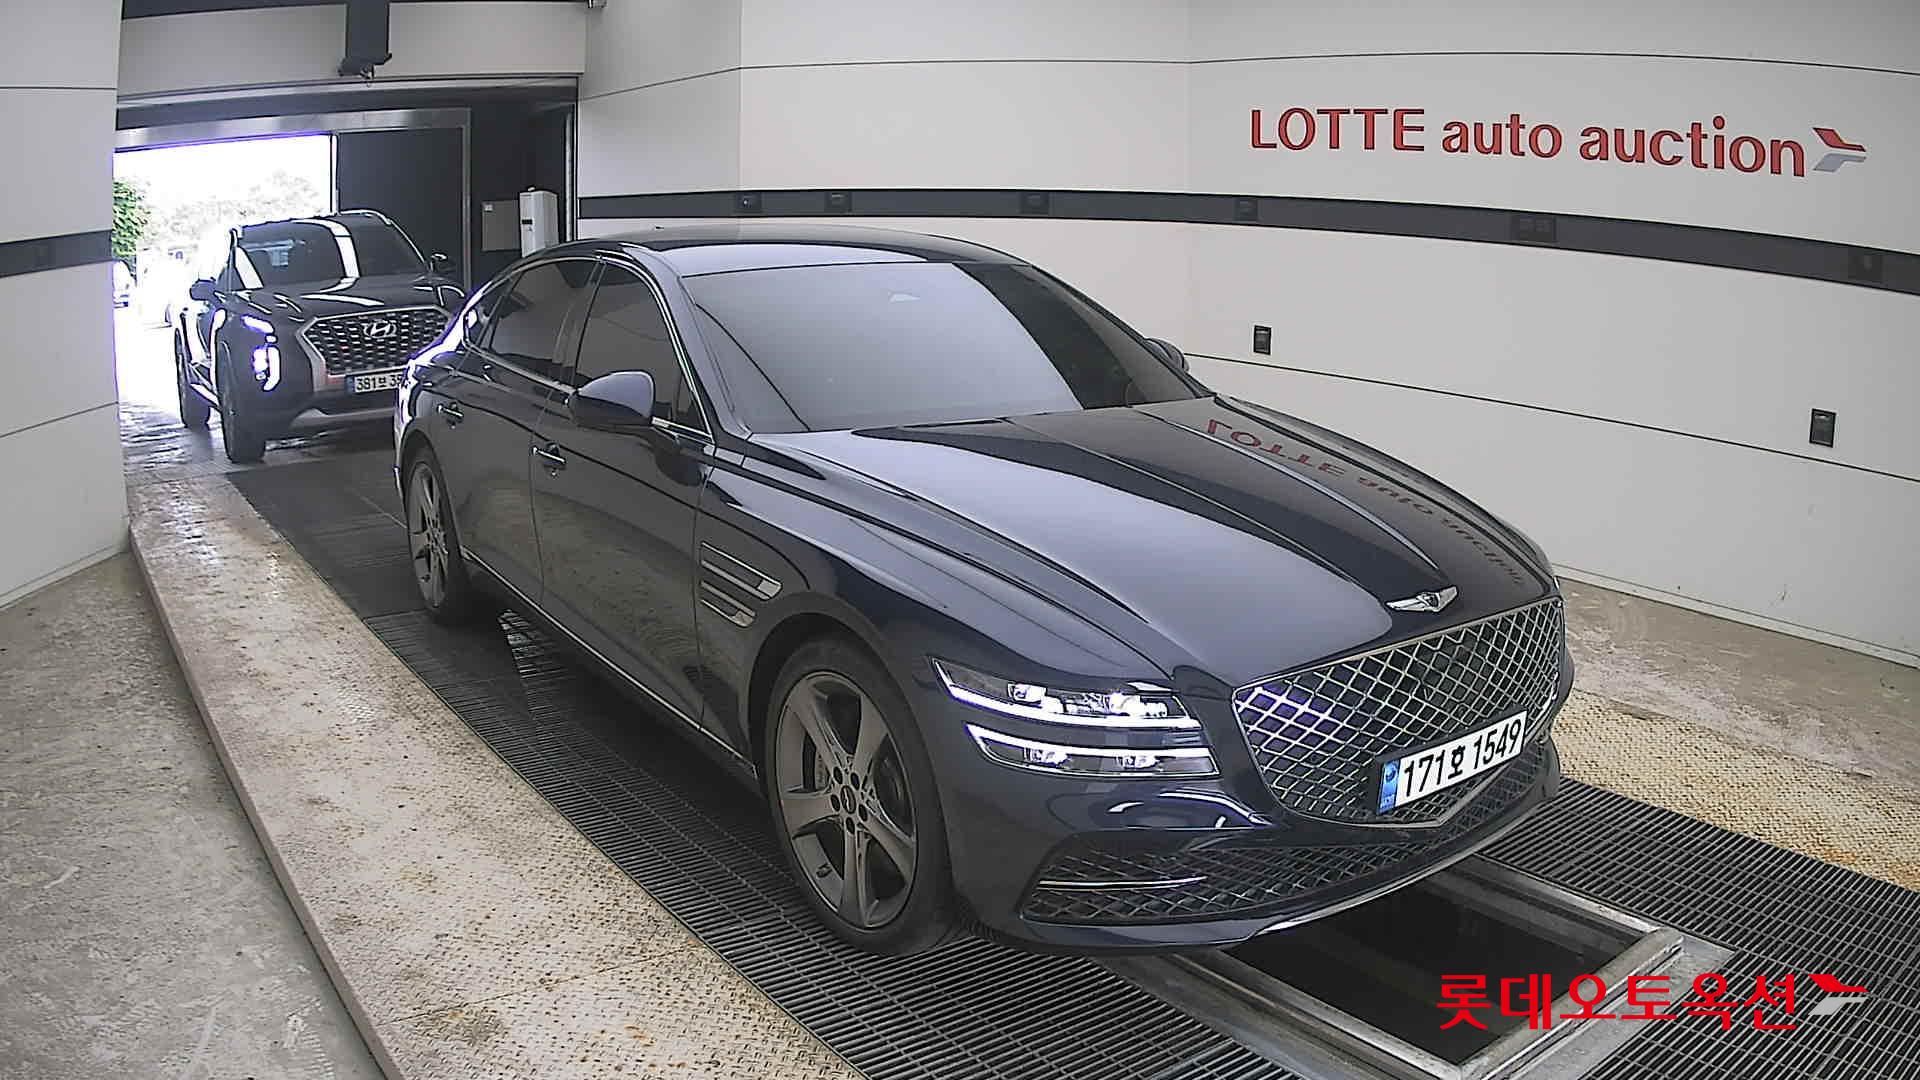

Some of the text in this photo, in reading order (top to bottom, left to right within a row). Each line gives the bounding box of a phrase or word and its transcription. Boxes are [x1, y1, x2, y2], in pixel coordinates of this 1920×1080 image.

[1249, 107, 1808, 178] LOTTE auto auction
[1403, 718, 1522, 798] 171호 1549
